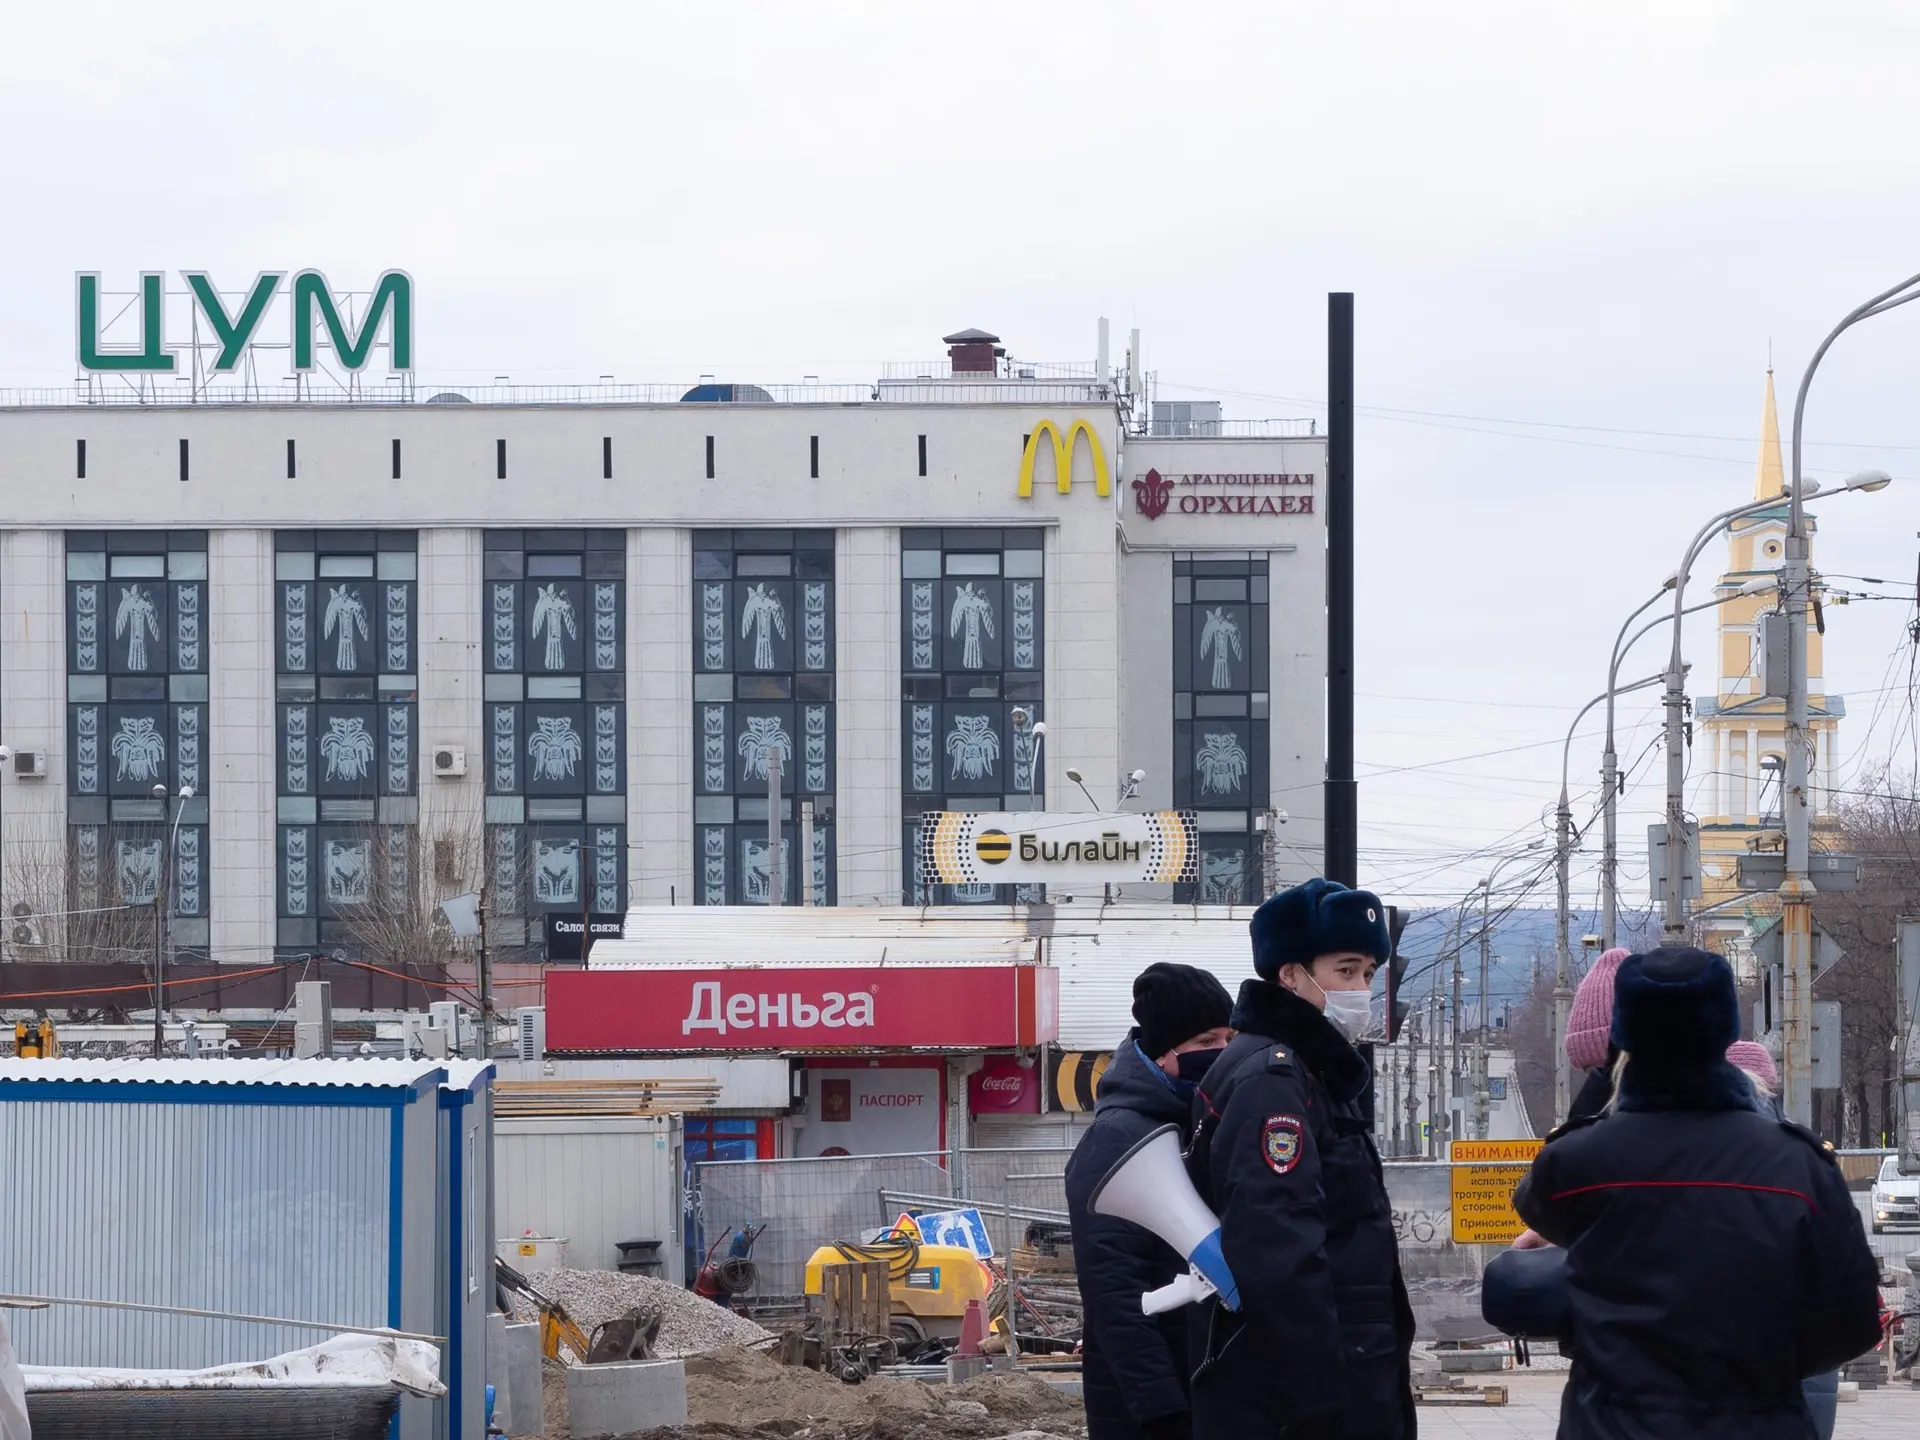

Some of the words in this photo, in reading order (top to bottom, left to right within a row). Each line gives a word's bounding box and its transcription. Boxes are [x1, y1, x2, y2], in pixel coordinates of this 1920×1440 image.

[75, 268, 415, 374] ЦУМ
[1180, 474, 1314, 486] ДРАГОЦЕННАЯ
[1179, 495, 1315, 516] ОРХИДЕЯ
[1018, 832, 1140, 863] Билайн
[590, 923, 621, 933] связи
[682, 981, 875, 1035] Деньга
[859, 1094, 924, 1106] ПАСПОРТ
[1455, 1190, 1494, 1200] тротуар
[1462, 1203, 1506, 1213] стороны
[1460, 1218, 1516, 1229] Приносим
